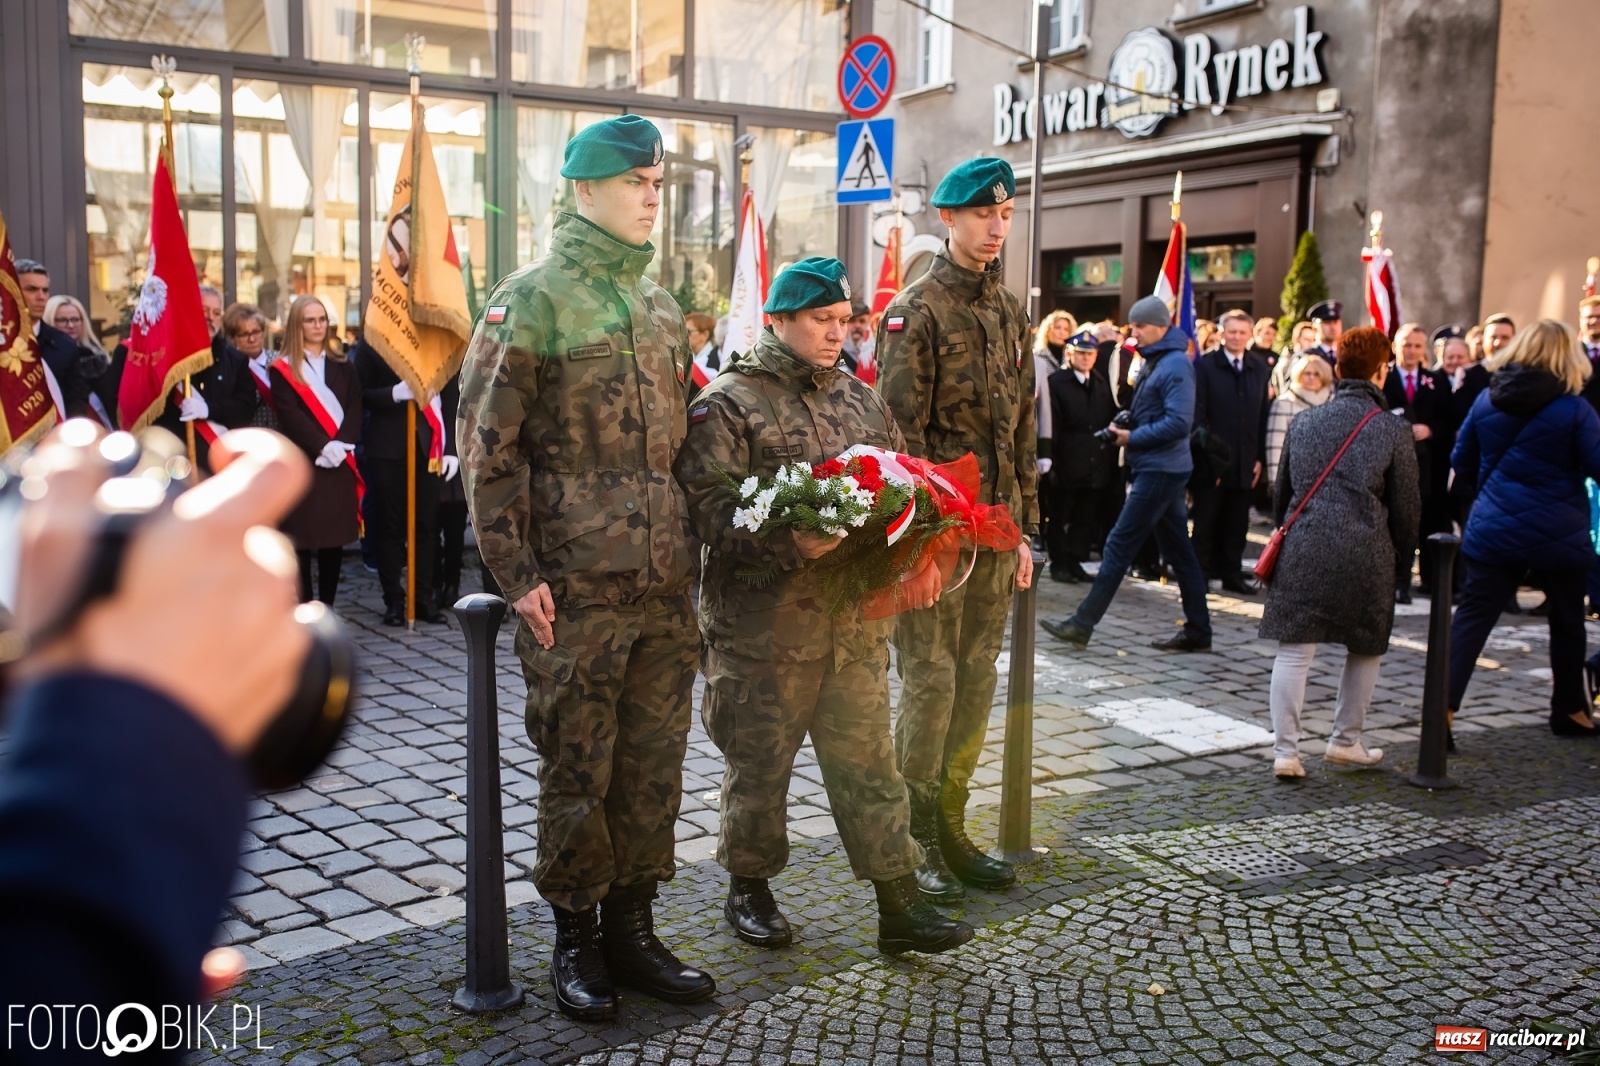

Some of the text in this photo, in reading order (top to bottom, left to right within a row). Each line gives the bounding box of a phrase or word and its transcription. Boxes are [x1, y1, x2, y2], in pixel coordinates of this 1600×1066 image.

[1183, 6, 1324, 116] Rynek
[371, 294, 402, 328] OŻENIA
[17, 390, 45, 417] 1920
